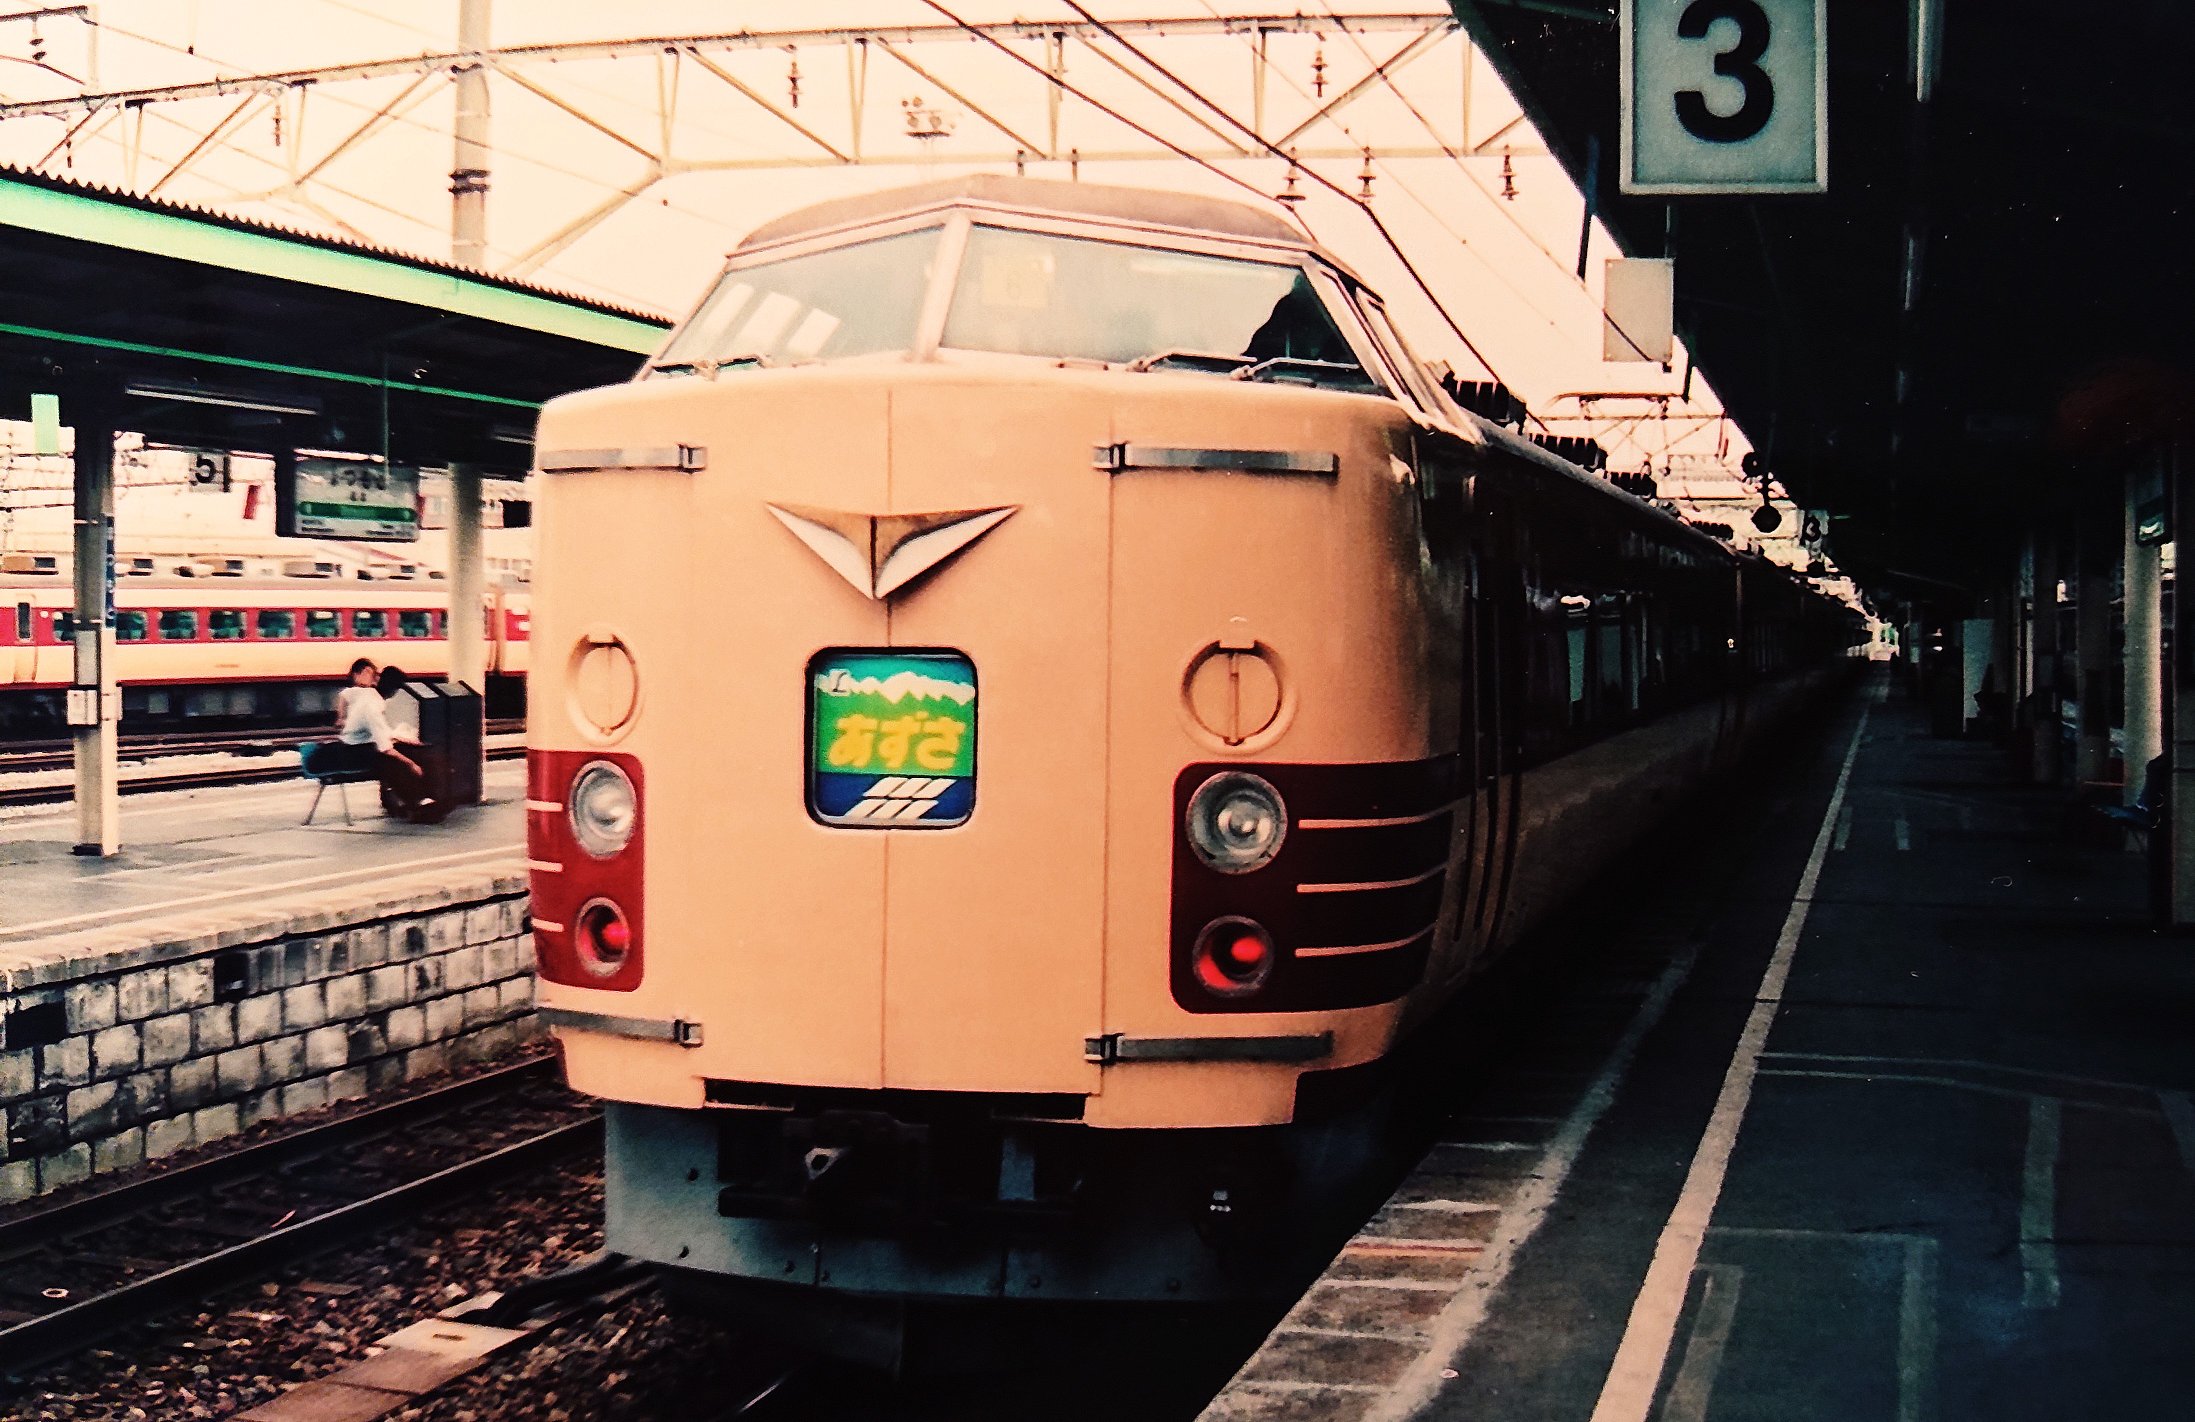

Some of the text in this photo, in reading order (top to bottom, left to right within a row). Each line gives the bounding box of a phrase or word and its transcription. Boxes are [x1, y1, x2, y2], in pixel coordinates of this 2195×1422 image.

[1674, 0, 1774, 143] 3
[195, 454, 216, 483] 5
[828, 711, 965, 770] あずさ
